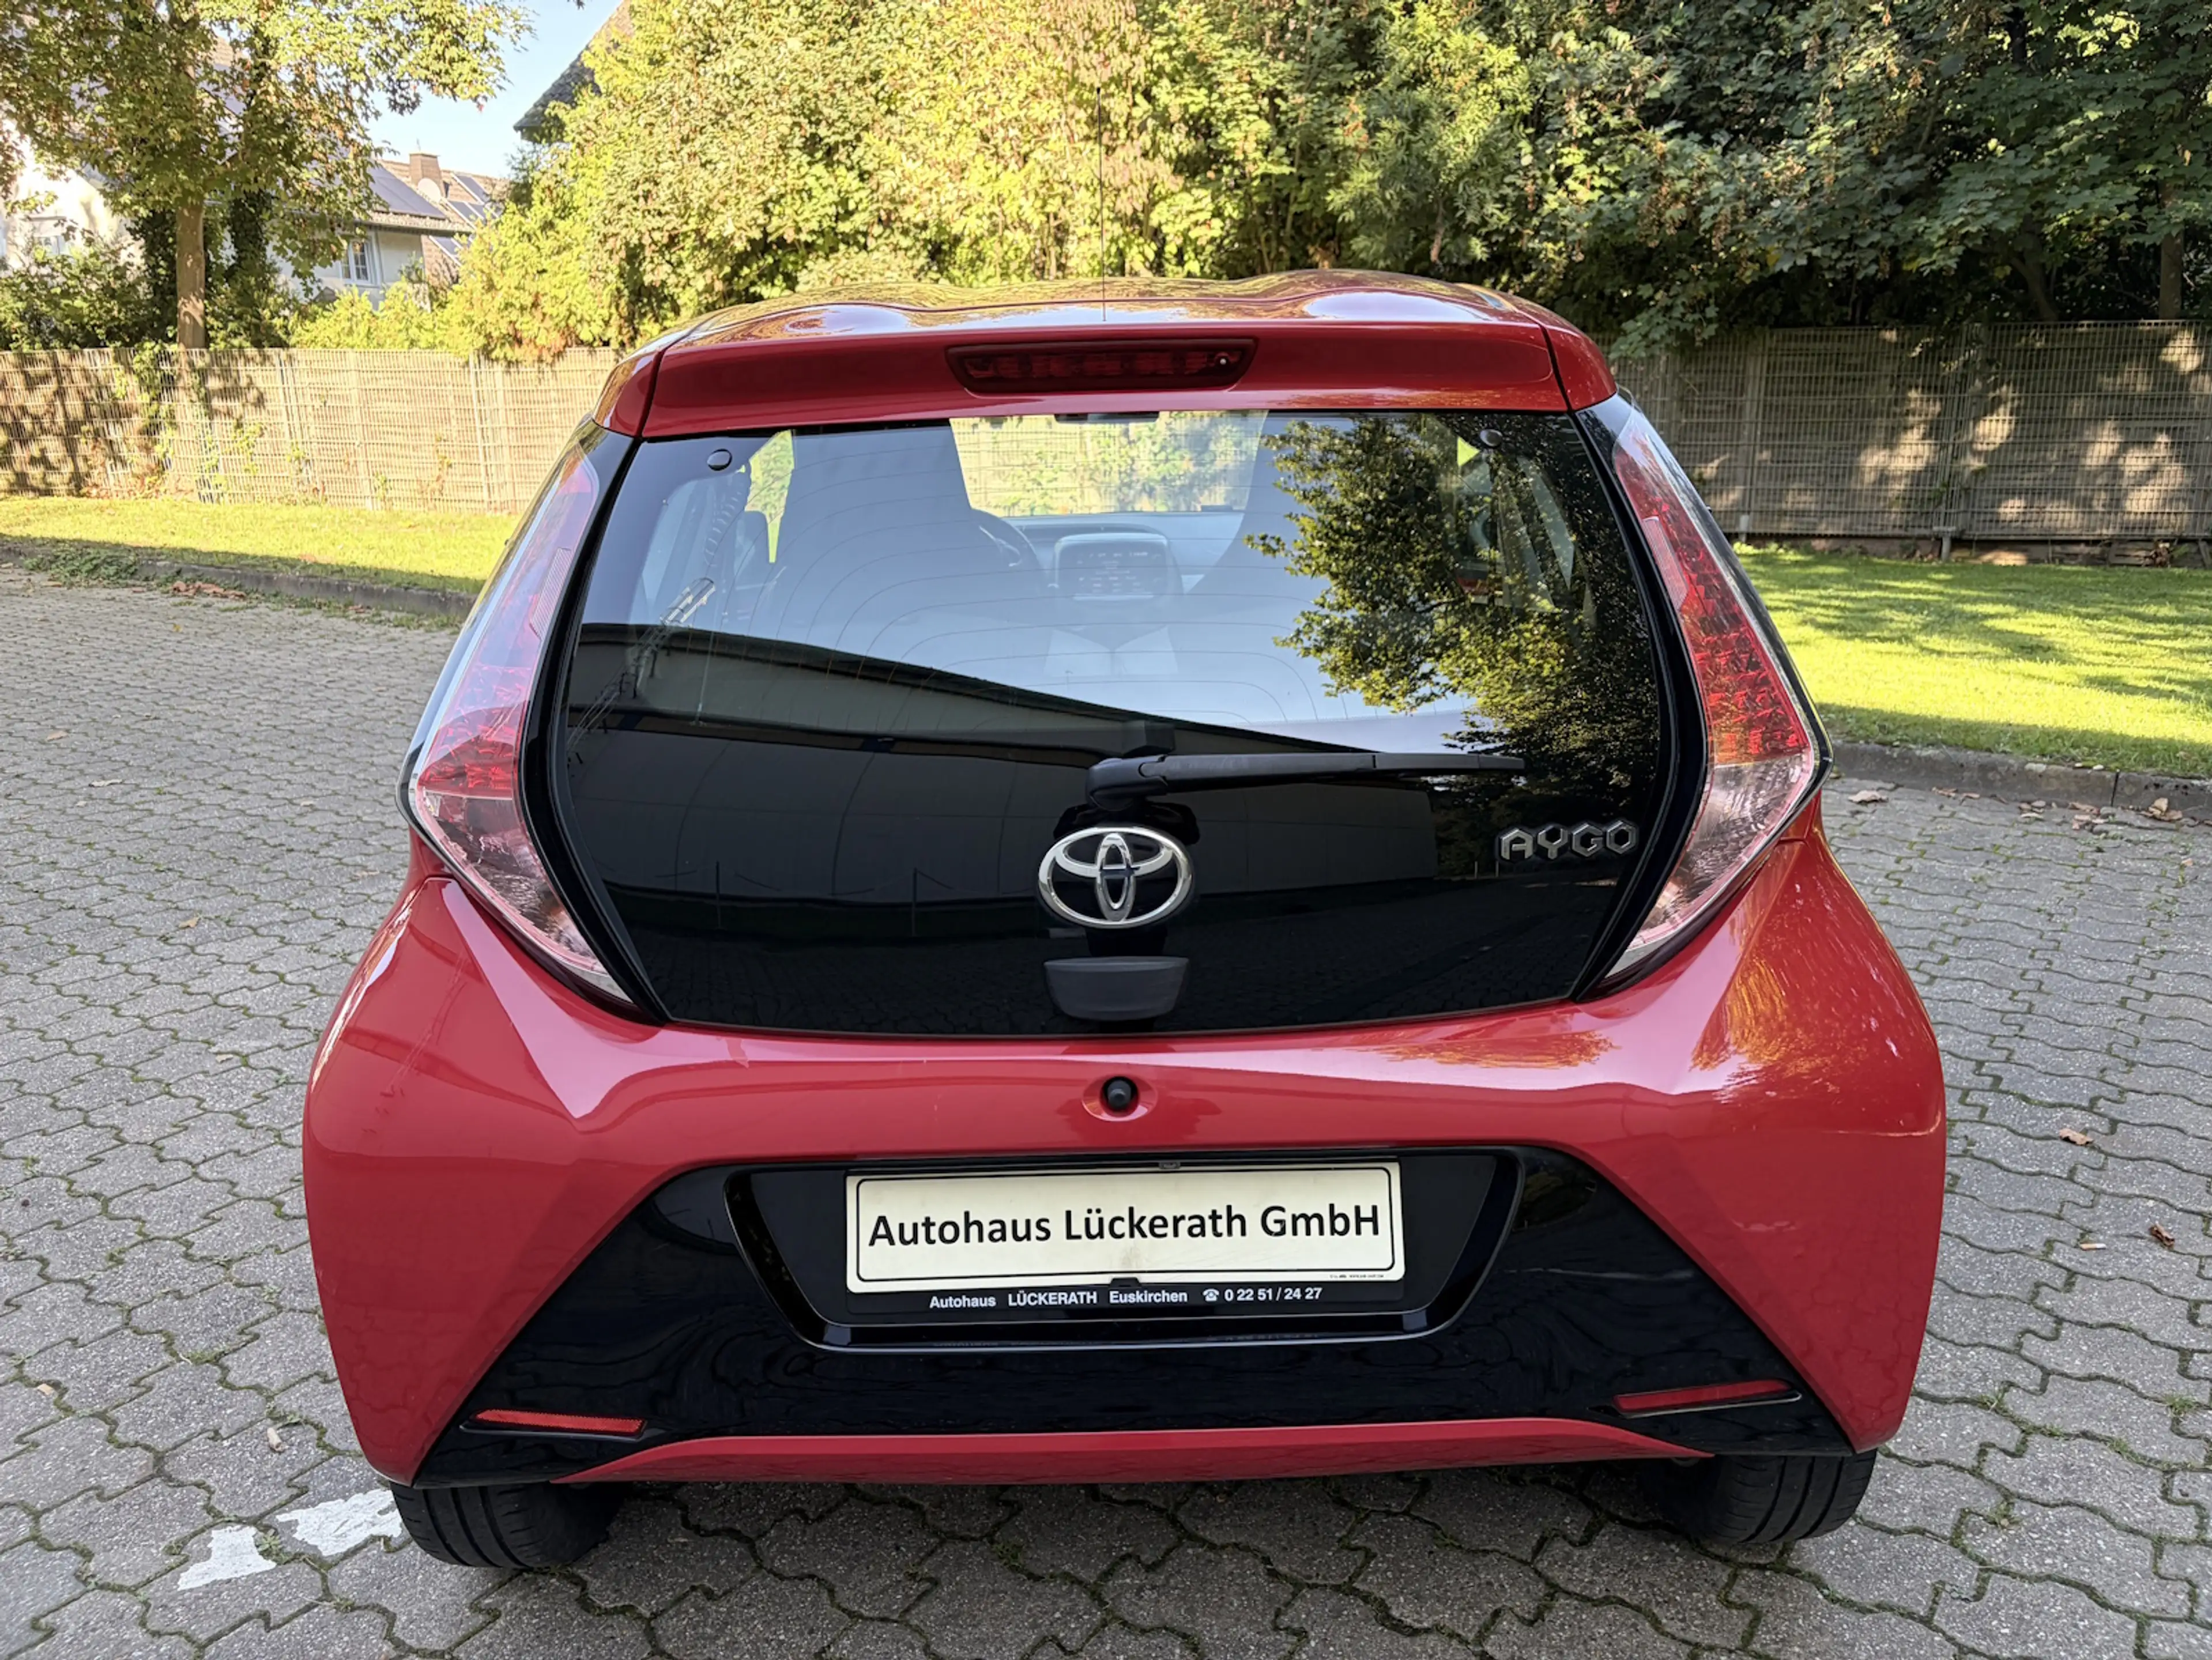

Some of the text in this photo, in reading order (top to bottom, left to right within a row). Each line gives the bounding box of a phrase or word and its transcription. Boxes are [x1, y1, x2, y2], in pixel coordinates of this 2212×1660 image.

[1500, 821, 1637, 860] AYGO
[869, 1203, 1380, 1246] Autohaus Lückerath GmbH
[929, 1293, 996, 1308] Autohaus
[1008, 1290, 1098, 1306] LÜCKERATH
[1109, 1289, 1188, 1304] Euskirchen
